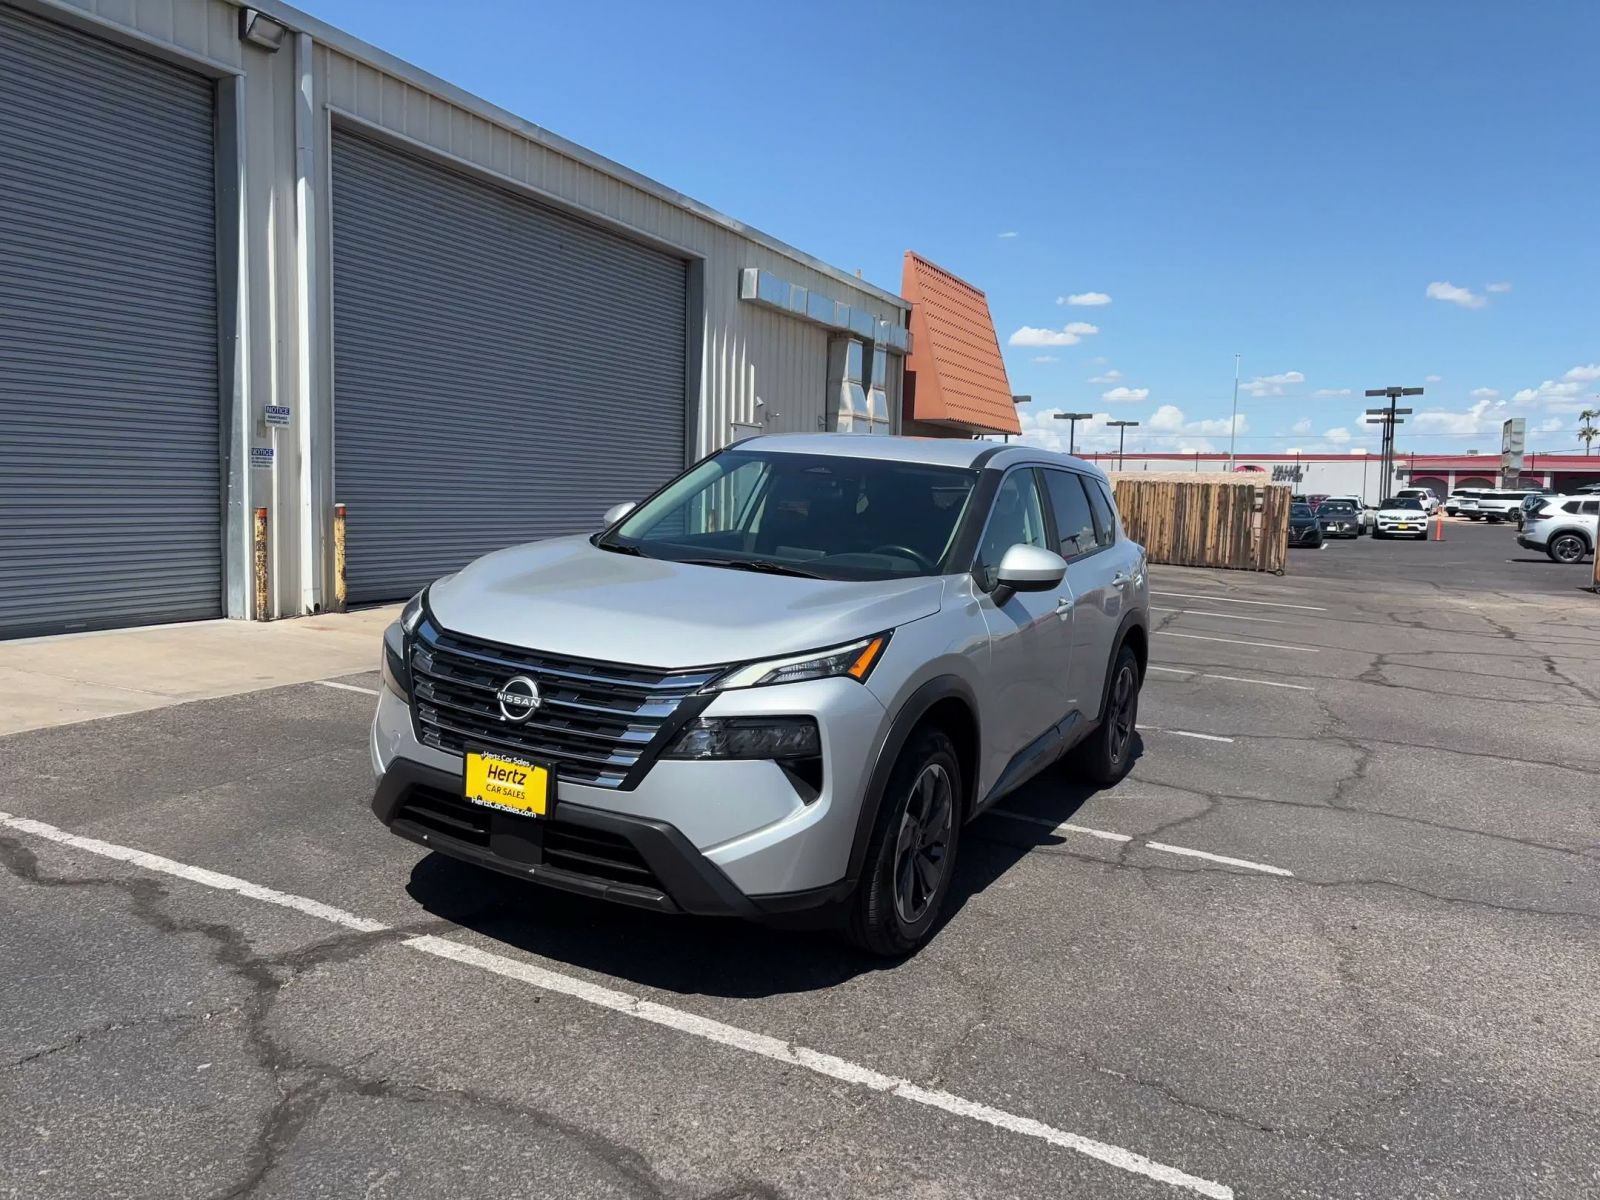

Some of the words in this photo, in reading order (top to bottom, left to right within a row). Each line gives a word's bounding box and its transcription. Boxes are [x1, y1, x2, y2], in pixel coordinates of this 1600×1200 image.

[497, 692, 540, 708] NISSAN
[483, 751, 500, 761] Hertz
[501, 755, 512, 763] Car
[513, 757, 530, 766] Sales
[488, 764, 527, 786] Hertz
[486, 783, 502, 794] CAR
[503, 788, 525, 800] SALES
[471, 796, 537, 818] HertzCarSales.com
